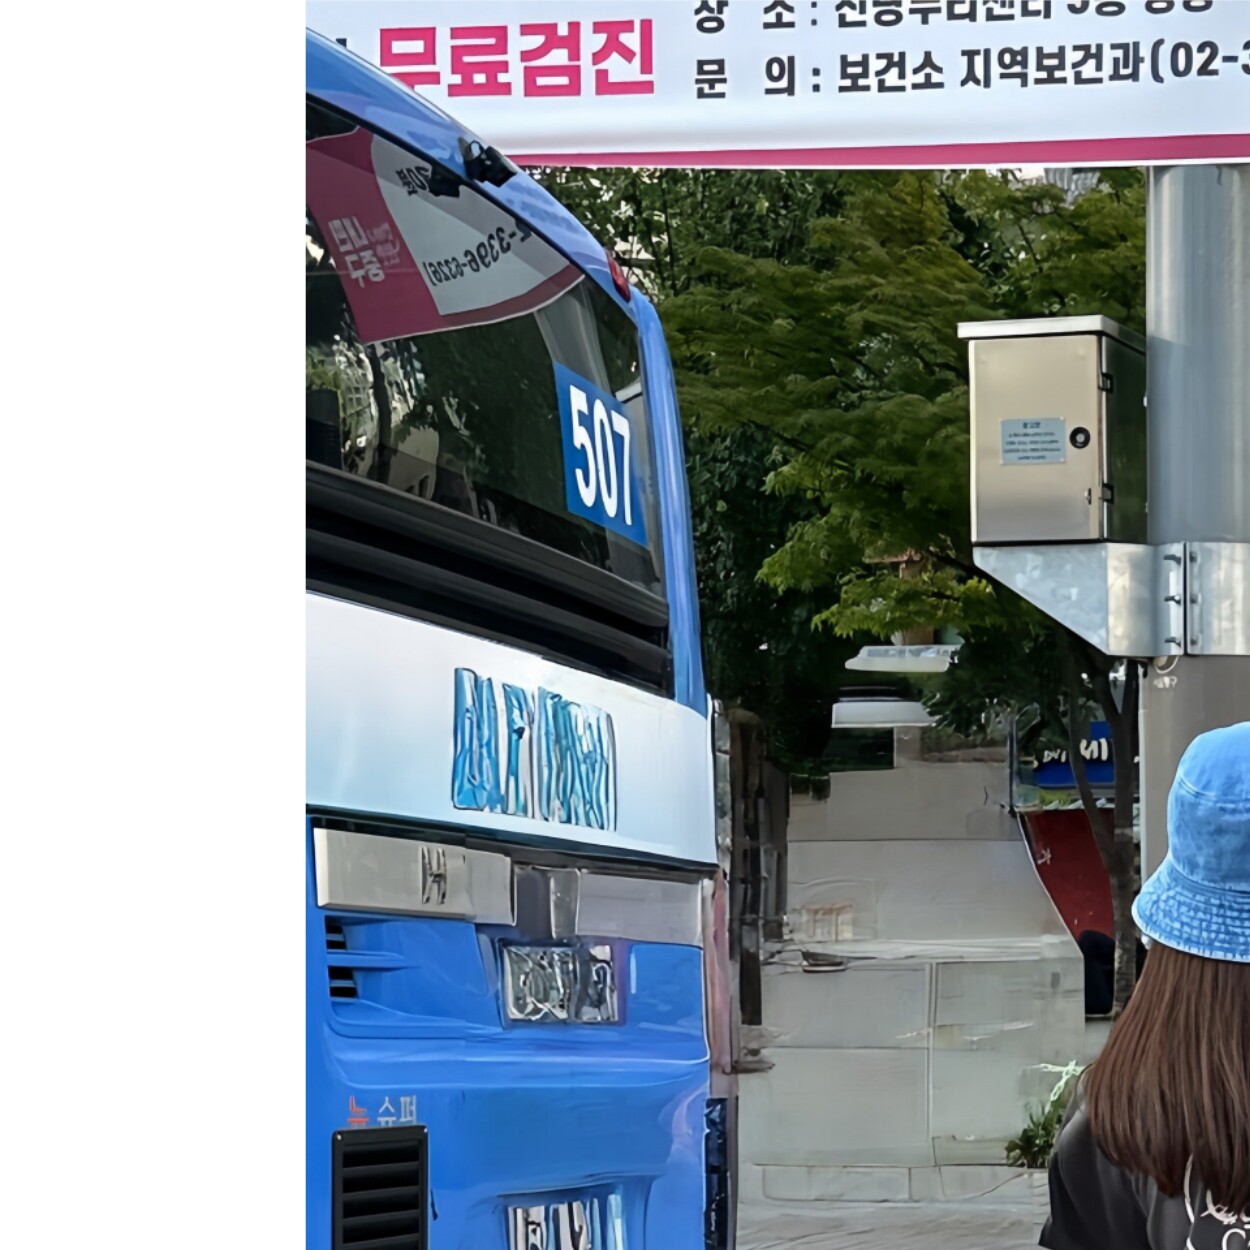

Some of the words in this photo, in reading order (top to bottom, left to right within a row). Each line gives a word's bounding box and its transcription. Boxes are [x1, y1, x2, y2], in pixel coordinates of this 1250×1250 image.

[379, 19, 655, 98] 무료검진
[694, 58, 728, 99] 문
[764, 55, 796, 96] 의
[838, 50, 945, 93] 보건소
[568, 385, 633, 527] 507
